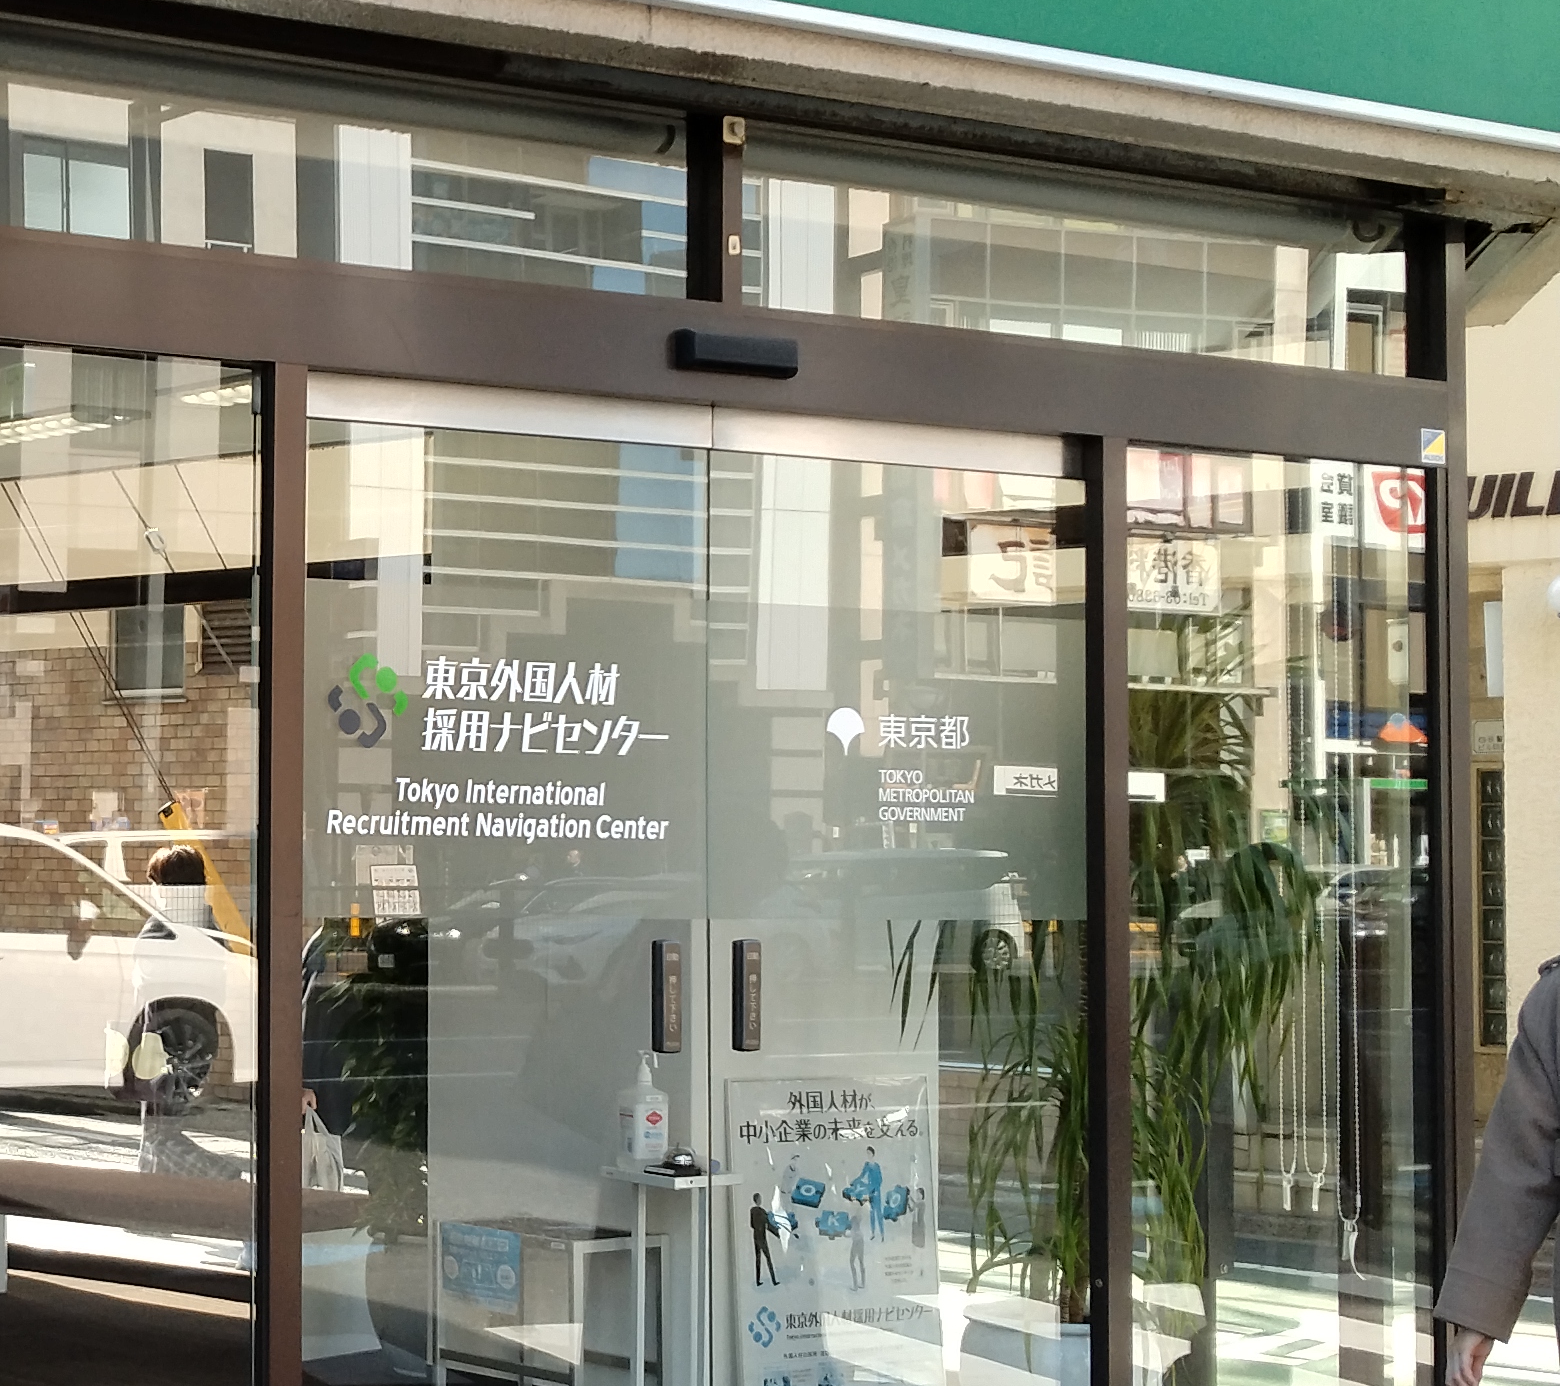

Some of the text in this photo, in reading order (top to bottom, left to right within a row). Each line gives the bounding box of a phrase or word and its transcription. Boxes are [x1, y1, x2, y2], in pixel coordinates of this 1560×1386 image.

[1468, 470, 1560, 520] UIL
[421, 655, 621, 706] 東京外国人材
[421, 706, 670, 756] 採用ナビセンター
[878, 714, 971, 749] 東京都
[396, 777, 606, 809] Tokyo International
[878, 769, 923, 784] TOKYO
[878, 787, 975, 804] METROPOLITAN
[327, 809, 670, 844] Recruitment Navigation Center
[878, 806, 967, 822] GOVERNMENT
